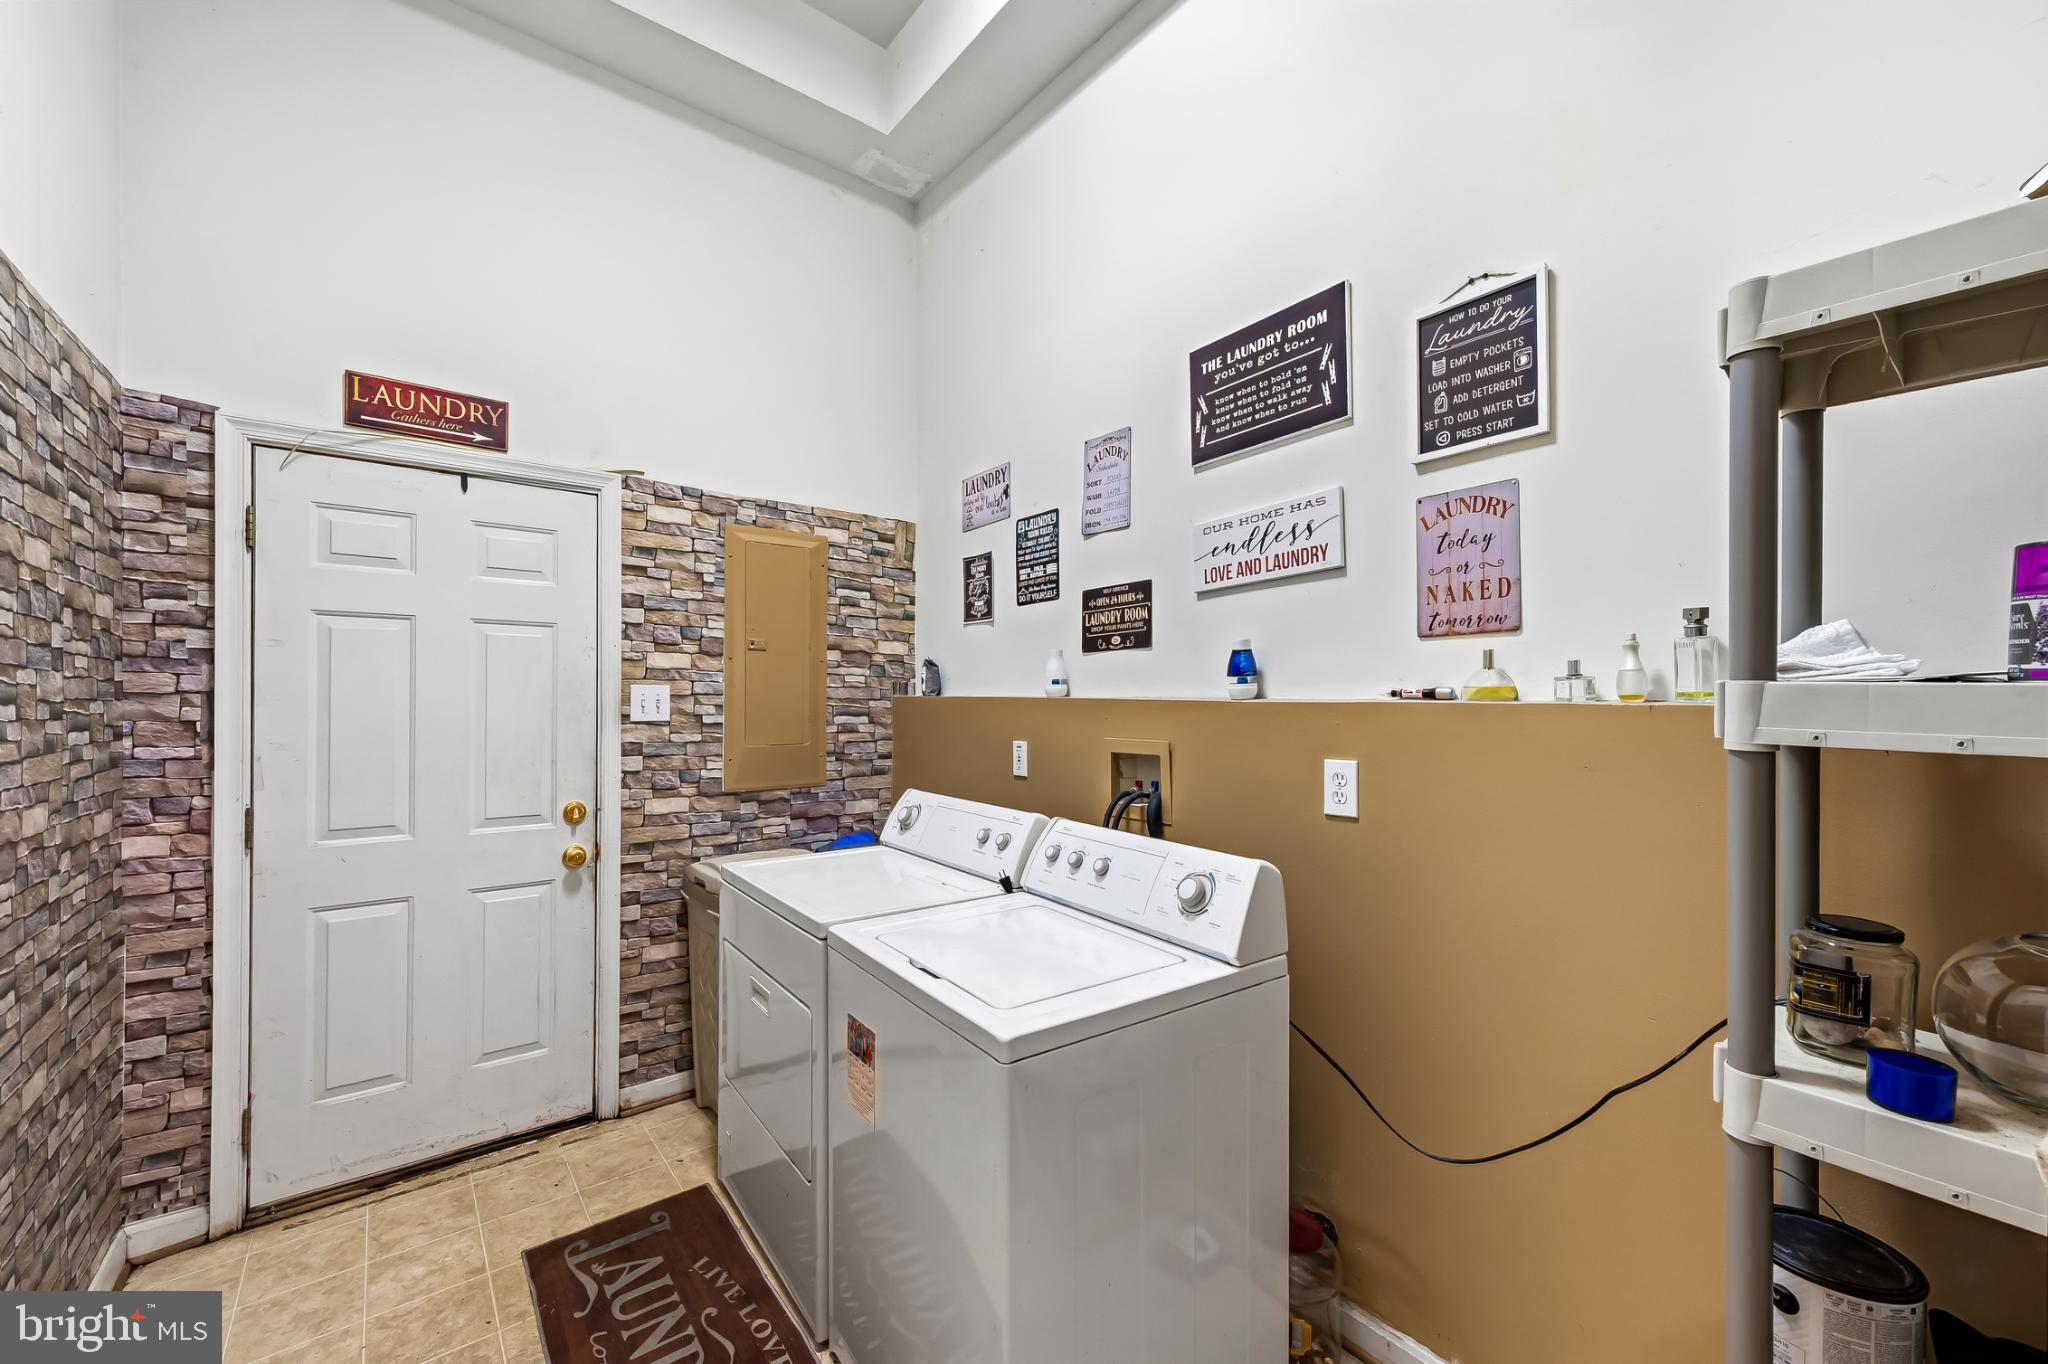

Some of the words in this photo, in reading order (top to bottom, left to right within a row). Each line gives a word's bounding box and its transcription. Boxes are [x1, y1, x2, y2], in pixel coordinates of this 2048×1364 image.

[1448, 311, 1465, 324] HOW
[1468, 307, 1477, 317] TO
[1479, 302, 1490, 313] DO
[1492, 294, 1513, 307] YOUR
[1201, 356, 1223, 375] THE
[1227, 329, 1283, 364] LAUNDRY
[1287, 309, 1328, 338] ROOM
[1424, 305, 1534, 354] Laundry
[1214, 360, 1253, 384] you've
[1257, 347, 1280, 367] got
[1450, 351, 1480, 369] EMPTY
[1483, 336, 1525, 357] POCKETS
[1215, 393, 1235, 406] know
[1236, 385, 1257, 397] when
[1259, 380, 1269, 388] to
[1271, 370, 1292, 384] hold
[1428, 380, 1448, 394] LOAD
[1451, 372, 1472, 387] INTO
[1475, 360, 1511, 379] WASHER
[1453, 392, 1469, 405] ADD
[1472, 375, 1525, 399] DETERGENT
[352, 376, 504, 427] LAUNDRY
[1211, 414, 1231, 426] know
[1233, 406, 1253, 418] when
[1255, 401, 1265, 410] to
[1267, 393, 1288, 405] walk
[1290, 384, 1313, 397] away
[1215, 402, 1235, 415] know
[1237, 395, 1257, 406] when
[1260, 390, 1270, 398] to
[1271, 380, 1291, 394] fold
[391, 410, 437, 427] Gathers
[438, 418, 463, 431] here
[1216, 423, 1230, 433] and
[1232, 416, 1253, 428] know
[1255, 408, 1276, 419] when
[1278, 403, 1288, 412] to
[1290, 396, 1308, 407] run
[1424, 418, 1440, 431] SET
[1443, 415, 1454, 426] TO
[1457, 409, 1479, 422] COLD
[1482, 399, 1514, 415] WATER
[1456, 425, 1483, 440] PRESS
[1486, 416, 1515, 433] START
[1086, 446, 1129, 473] LAUNDRY
[965, 466, 1007, 497] LAUNDRY
[1086, 479, 1102, 489] SORT
[1086, 492, 1102, 501] WASH
[1025, 512, 1057, 531] LAUNDRY
[1084, 520, 1101, 530] IRON
[1085, 507, 1101, 516] FOLD
[1203, 521, 1234, 535] OUR
[1239, 508, 1284, 527] HOME
[1289, 496, 1327, 514] HAS
[1420, 495, 1515, 532] LAUNDRY
[1194, 514, 1339, 562] endless
[1436, 528, 1496, 555] today
[1204, 563, 1233, 584] LOVE
[1236, 557, 1262, 578] AND
[1265, 543, 1328, 573] LAUNDRY
[1456, 561, 1476, 575] or
[1031, 589, 1057, 601] YOURSELF
[1096, 597, 1110, 607] OPEN
[1111, 595, 1118, 605] 24
[1119, 592, 1136, 603] HOURS
[1426, 576, 1512, 606] NAKED
[1085, 610, 1123, 627] LAUNDRY
[1125, 606, 1149, 622] ROOM
[1117, 622, 1132, 630] PANTS
[1428, 611, 1511, 632] tomorrow
[692, 1256, 746, 1304] LIVE
